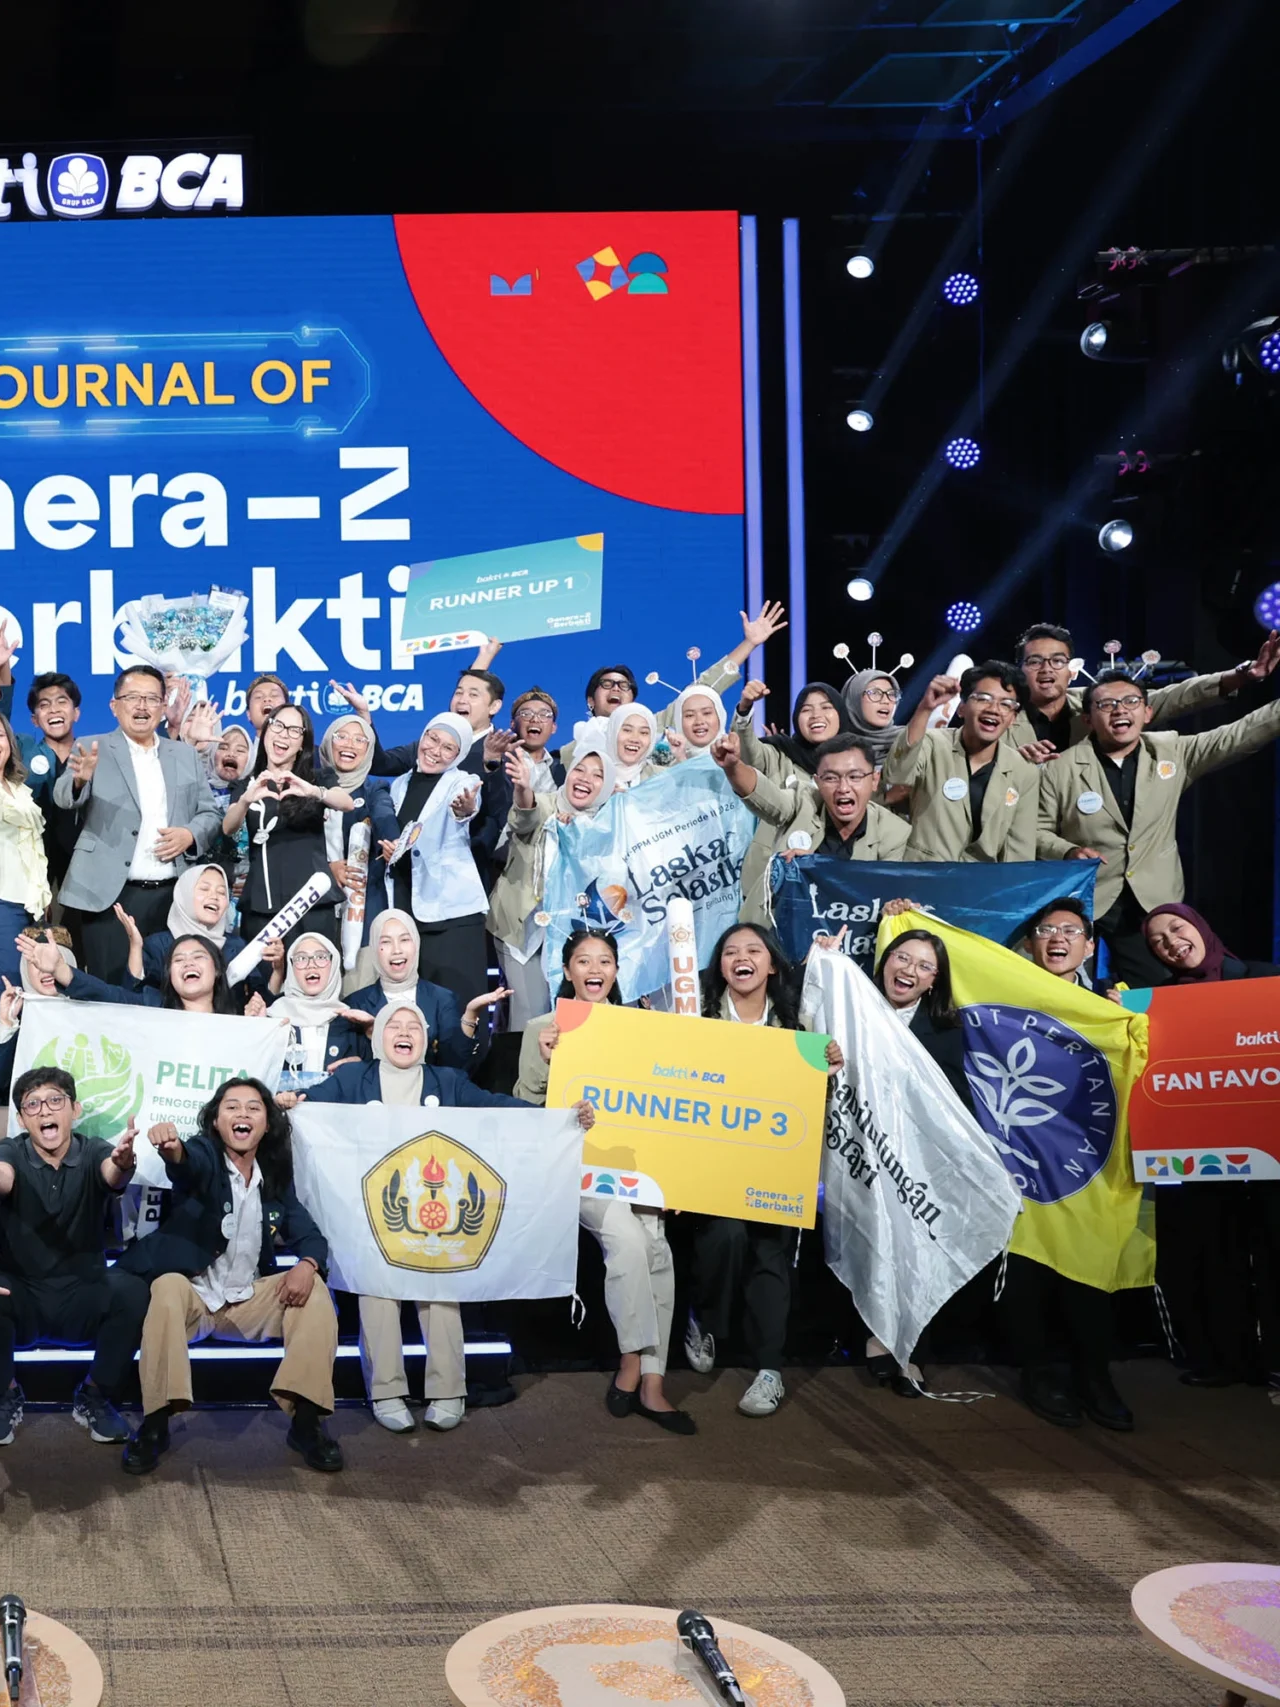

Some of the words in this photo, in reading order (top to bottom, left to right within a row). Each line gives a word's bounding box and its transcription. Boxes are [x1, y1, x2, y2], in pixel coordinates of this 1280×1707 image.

[115, 153, 245, 212] BCA
[251, 359, 331, 404] OF
[429, 584, 522, 611] RUNNER
[528, 579, 559, 595] UP
[564, 577, 574, 590] 1
[362, 683, 424, 711] BCA
[652, 829, 674, 843] UGM
[674, 813, 709, 833] Periode
[256, 886, 320, 946] PELITA
[347, 889, 365, 921] GM
[673, 956, 697, 1015] UGM
[1236, 1030, 1280, 1047] bakti
[652, 1061, 688, 1079] bakti
[702, 1071, 725, 1084] BCA
[1152, 1071, 1204, 1092] FAN
[581, 1085, 711, 1126] RUNNER
[720, 1104, 762, 1132] UP
[770, 1112, 788, 1136] 3
[1022, 1014, 1111, 1179] PERTANIAN
[754, 1199, 803, 1214] Berbakti
